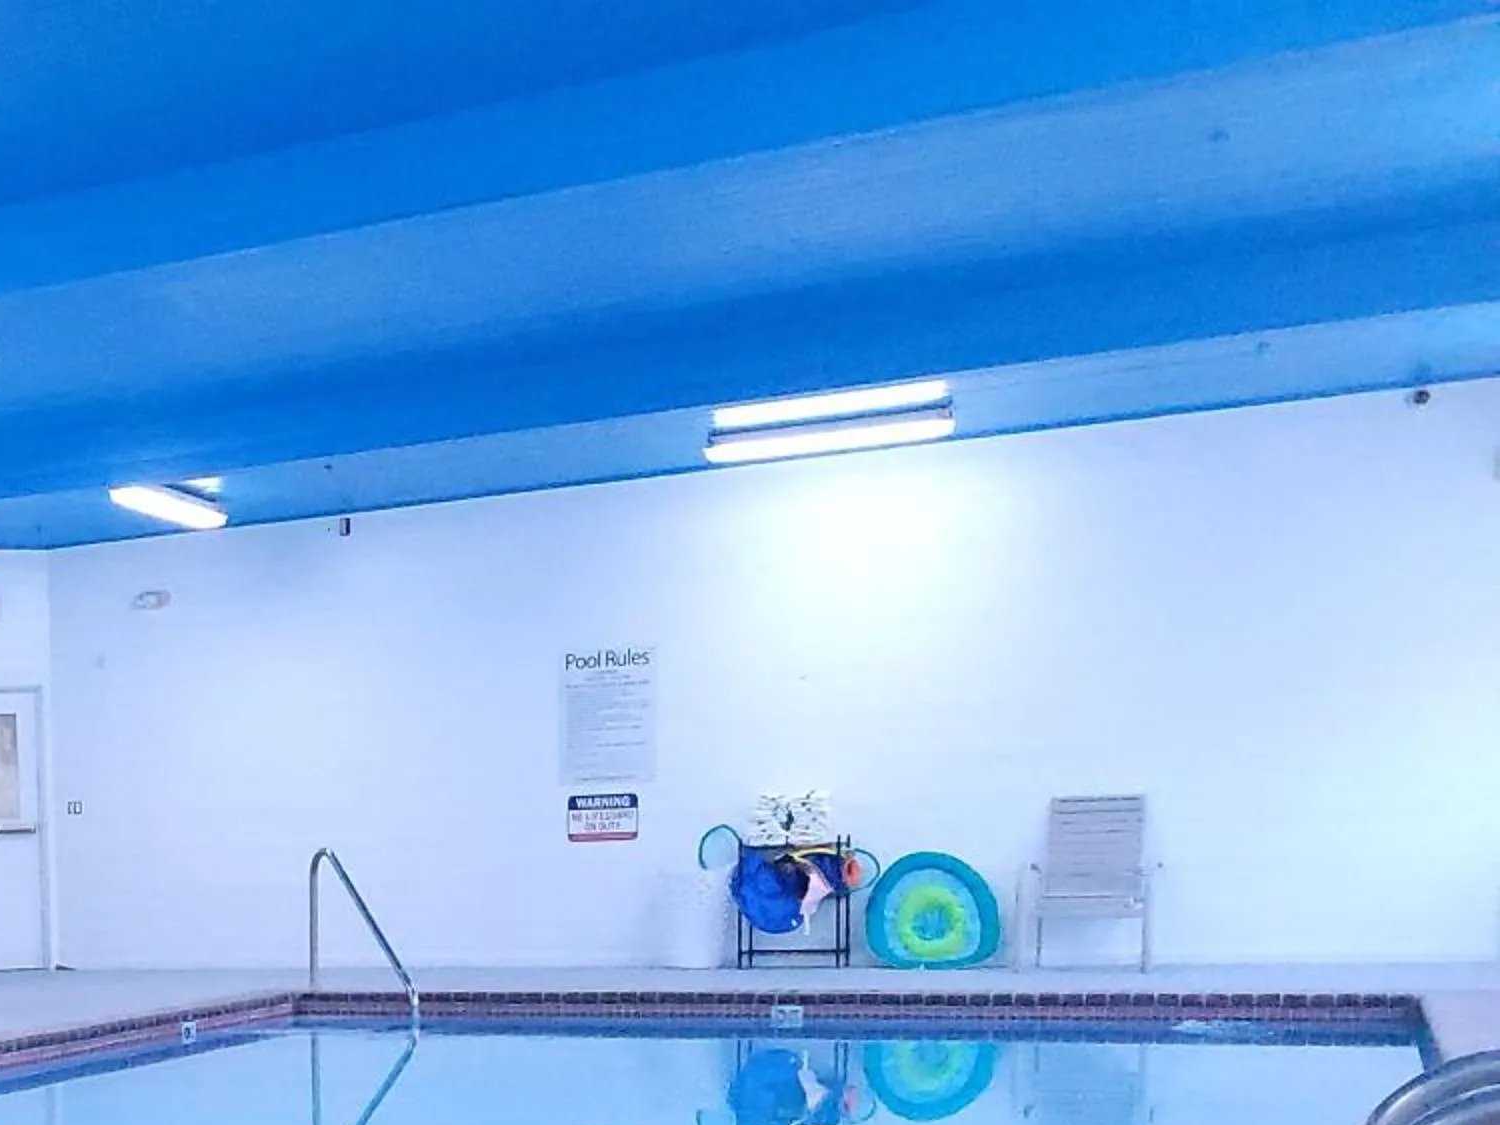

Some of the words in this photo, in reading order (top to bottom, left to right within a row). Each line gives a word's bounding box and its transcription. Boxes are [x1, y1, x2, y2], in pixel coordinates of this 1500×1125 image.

[565, 650, 601, 671] Pool
[605, 648, 650, 668] Rules
[575, 795, 631, 809] WARNING
